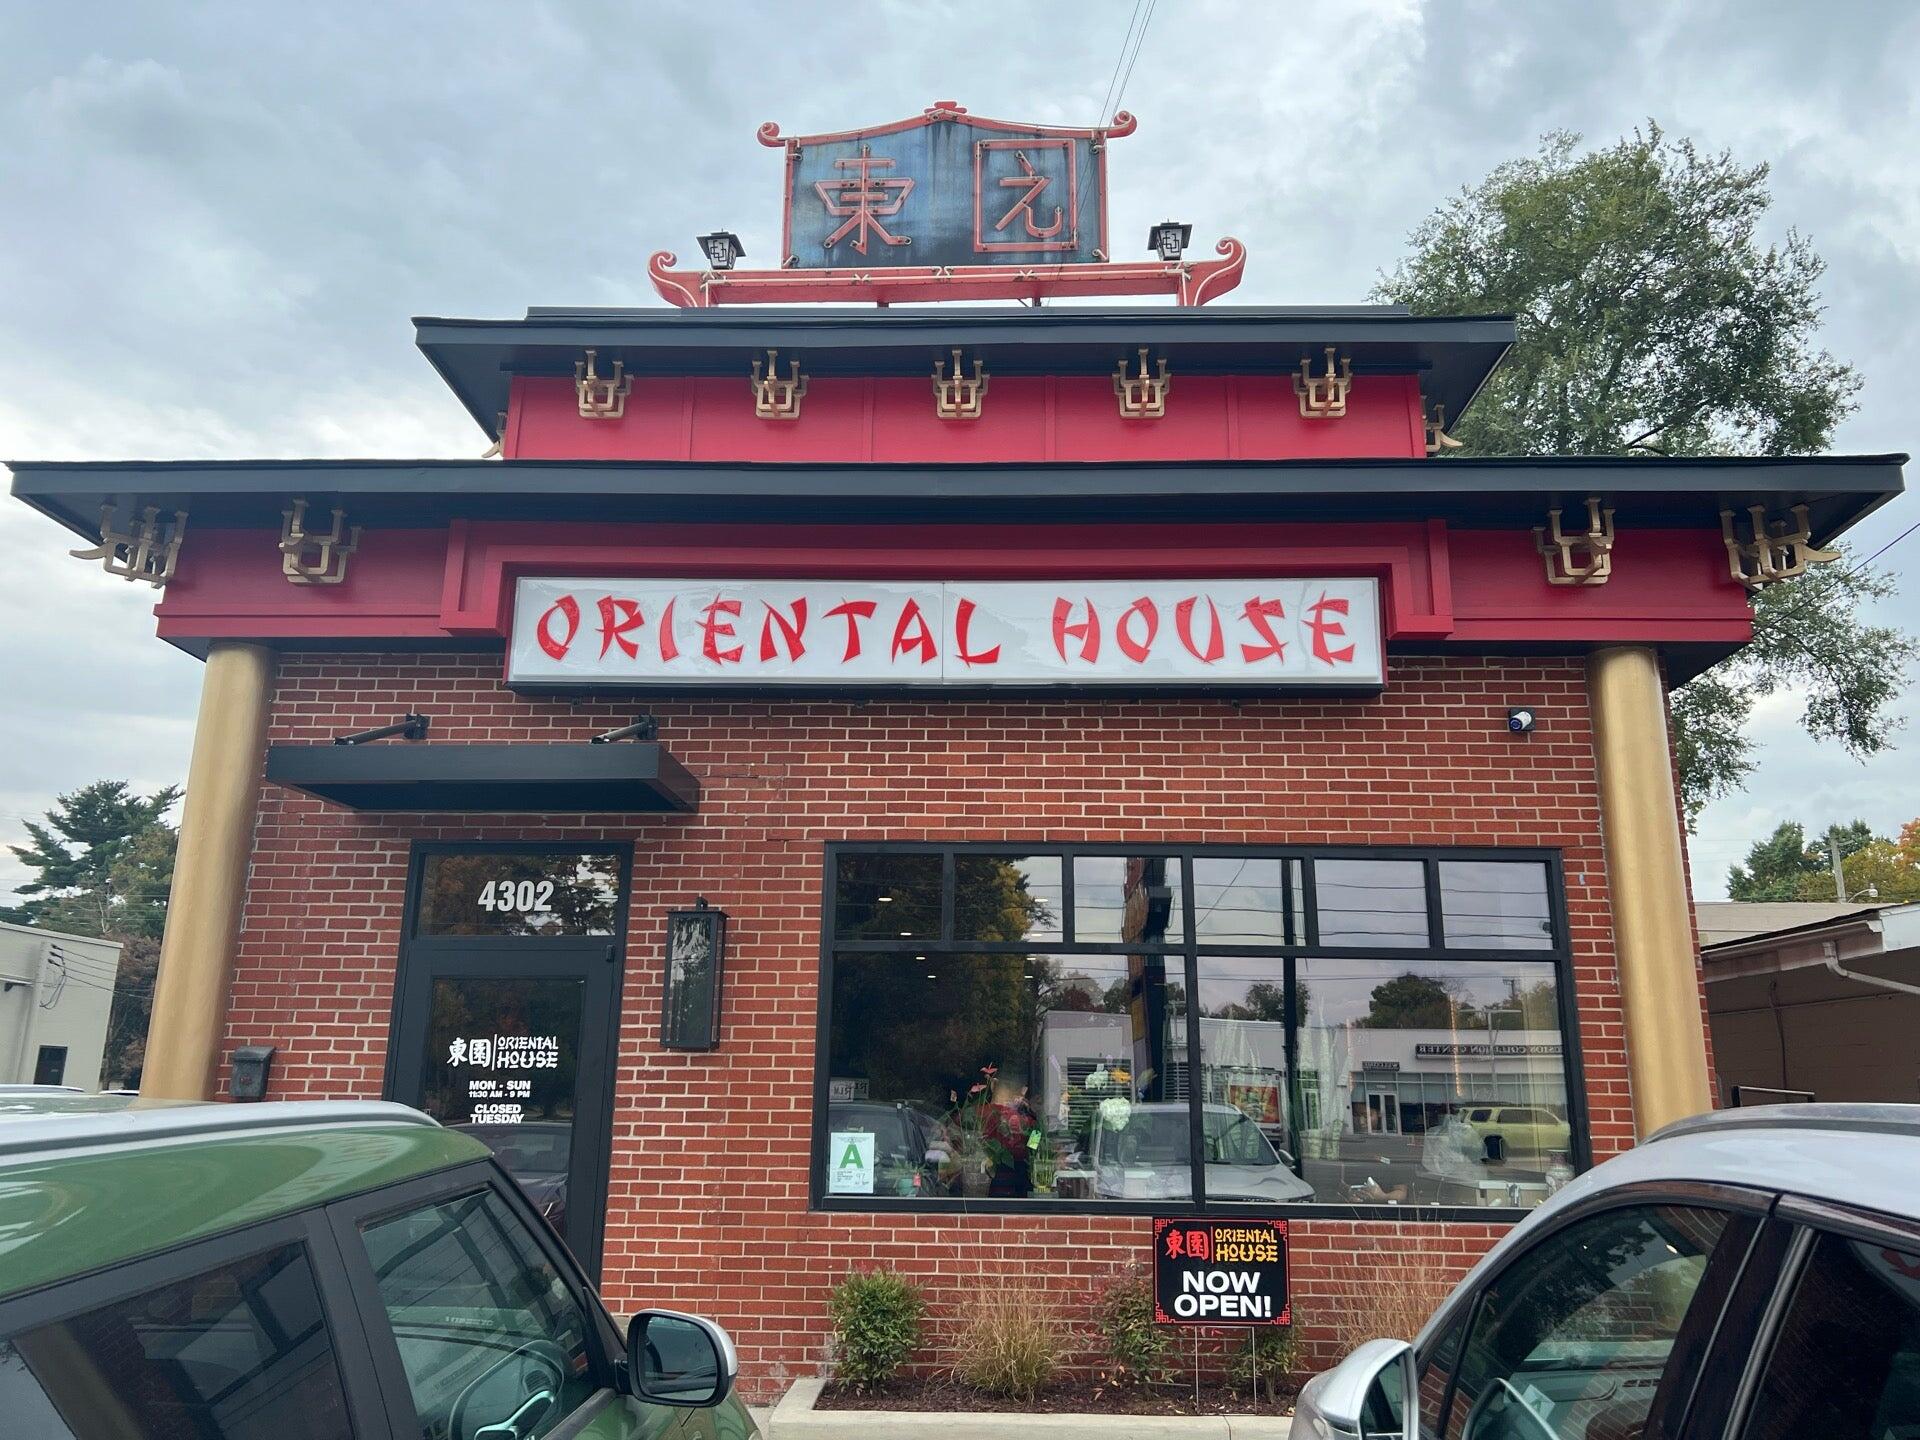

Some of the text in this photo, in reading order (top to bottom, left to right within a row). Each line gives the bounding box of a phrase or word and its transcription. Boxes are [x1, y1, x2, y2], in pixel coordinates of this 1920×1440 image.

[535, 588, 1357, 667] ORIENTAL HOUSE
[477, 880, 554, 912] 4302
[498, 1036, 558, 1049] ORIENTAL
[497, 1051, 558, 1068] HOUSE
[469, 1081, 496, 1090] MON
[506, 1081, 531, 1090] SUN
[474, 1104, 521, 1114] CLOSED
[470, 1114, 524, 1124] TUESDAY
[839, 1144, 864, 1169] A
[1215, 1229, 1277, 1243] ORIENTAL
[1216, 1244, 1278, 1262] HOUSE
[1183, 1271, 1261, 1293] NOW
[1174, 1294, 1272, 1318] OPEN!
